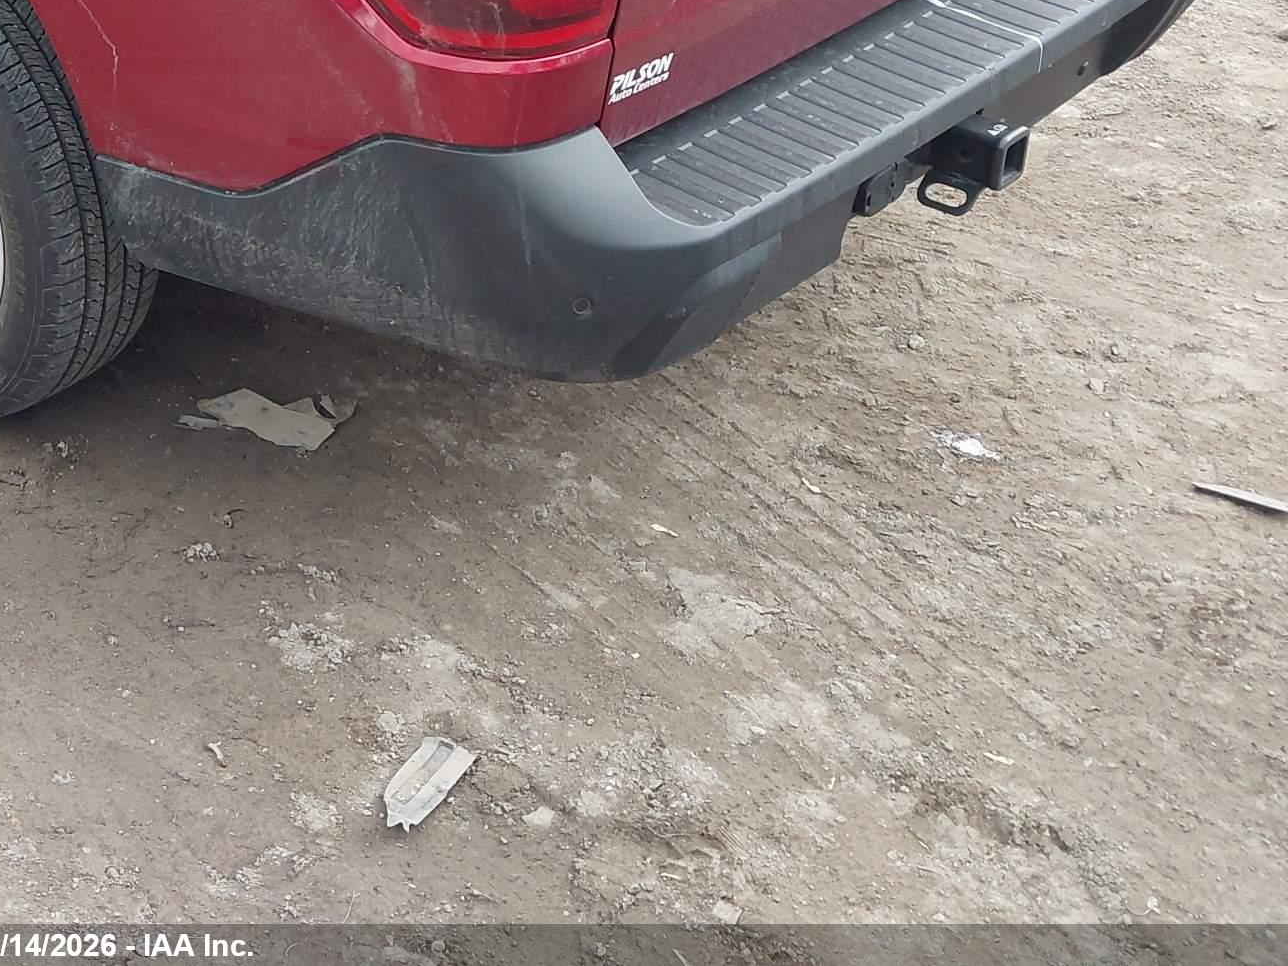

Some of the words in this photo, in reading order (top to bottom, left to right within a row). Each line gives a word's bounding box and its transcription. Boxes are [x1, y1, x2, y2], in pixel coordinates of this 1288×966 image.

[607, 87, 633, 106] Auto
[632, 71, 670, 94] Centers
[609, 52, 674, 96] PILSON
